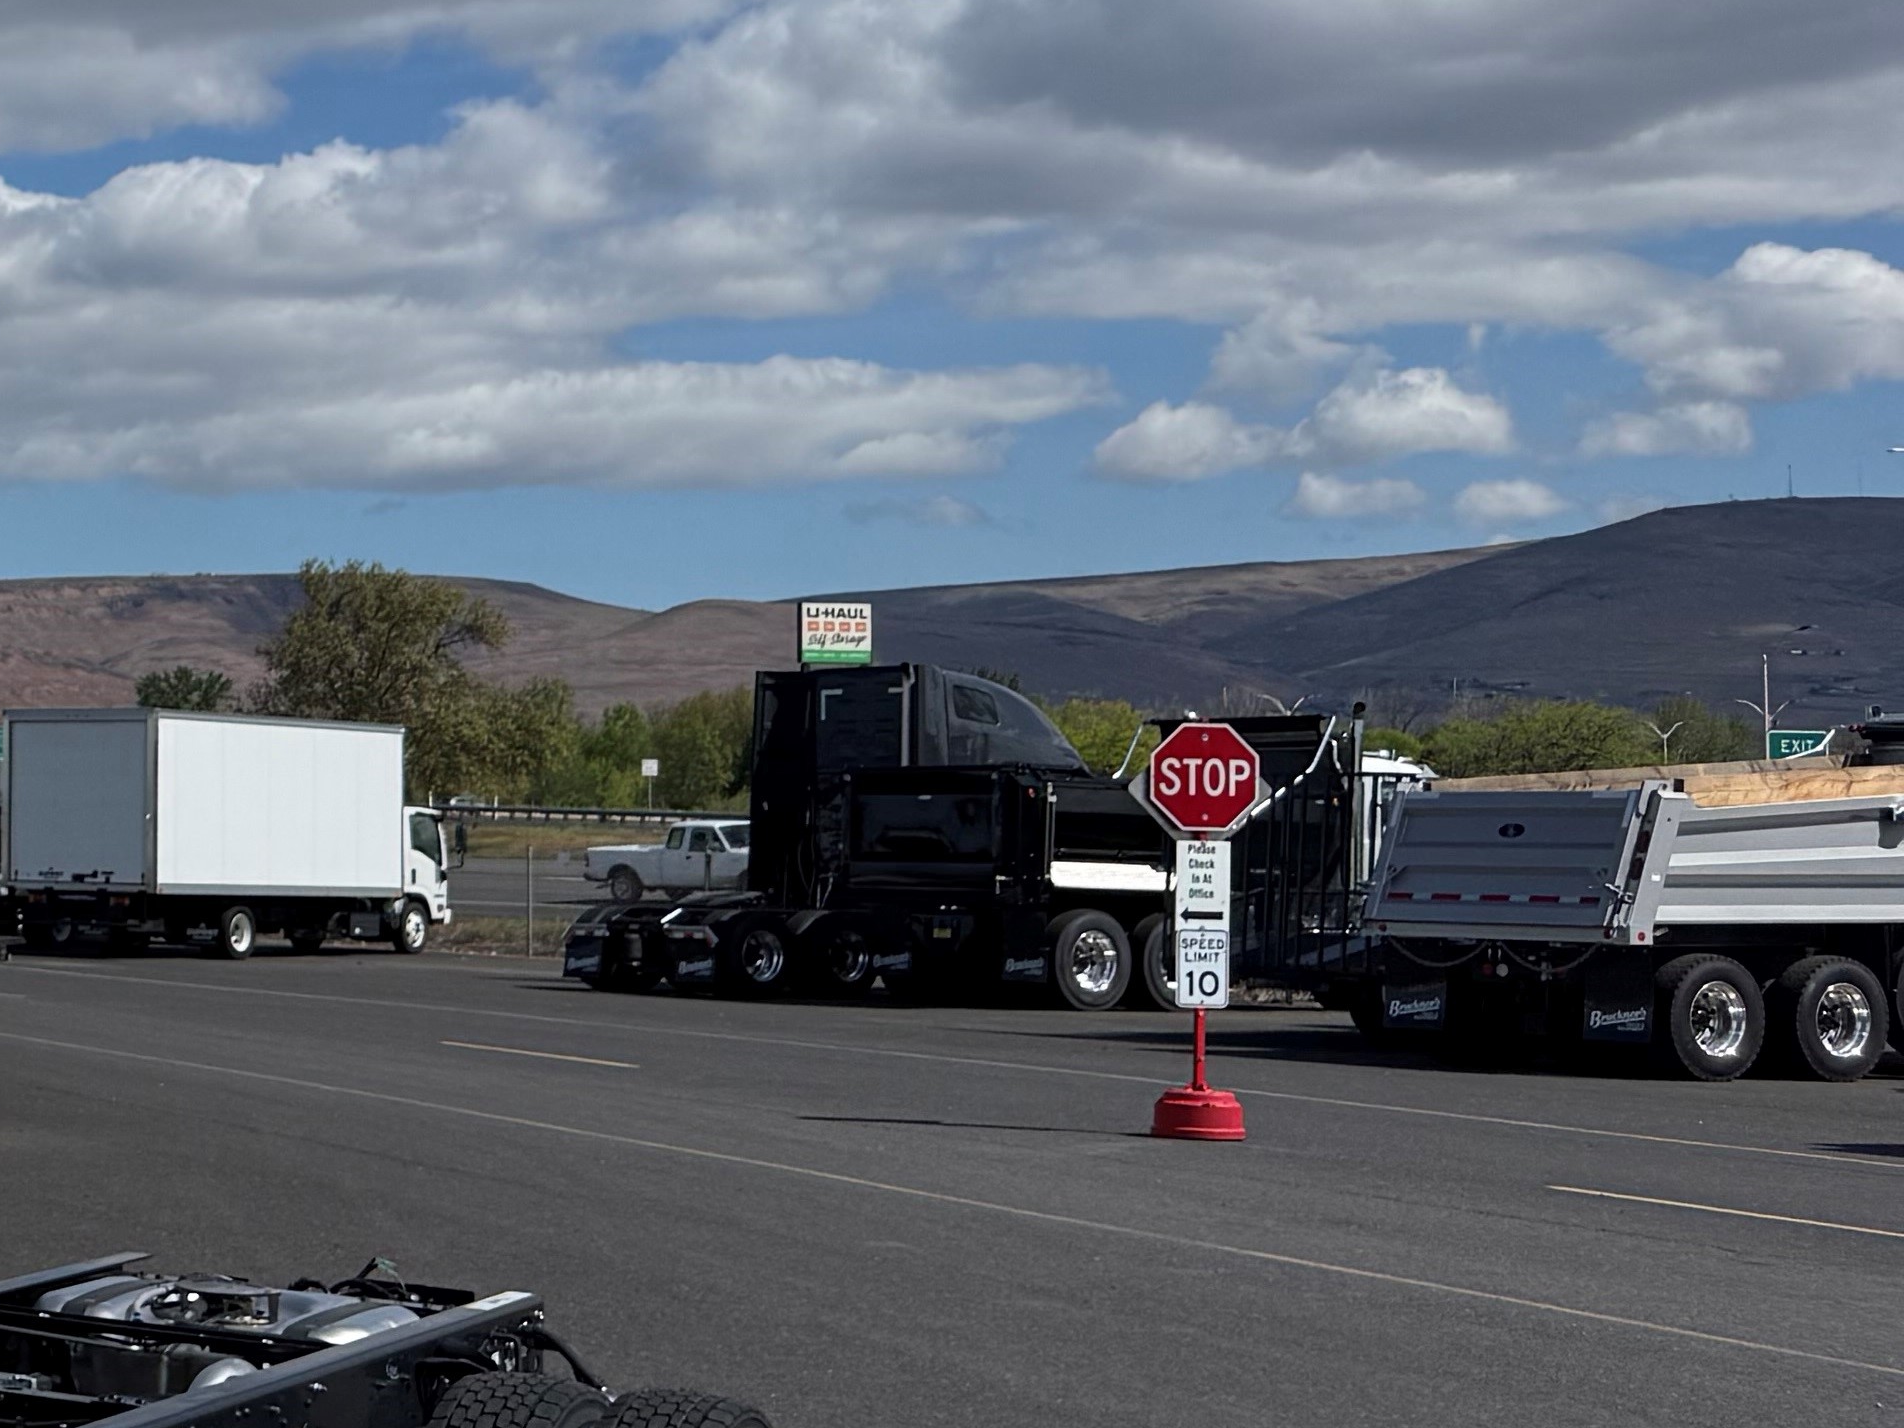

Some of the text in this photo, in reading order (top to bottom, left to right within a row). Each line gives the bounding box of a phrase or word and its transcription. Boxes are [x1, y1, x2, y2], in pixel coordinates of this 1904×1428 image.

[806, 607, 868, 619] U-HAUL
[1780, 739, 1815, 753] EXIT
[1158, 757, 1251, 797] STOP
[1187, 843, 1216, 854] Please
[1188, 858, 1214, 869] Check
[1188, 887, 1214, 899] Office
[1180, 938, 1225, 951] SPEED
[1184, 951, 1220, 963] LIMIT
[1185, 970, 1220, 997] 10
